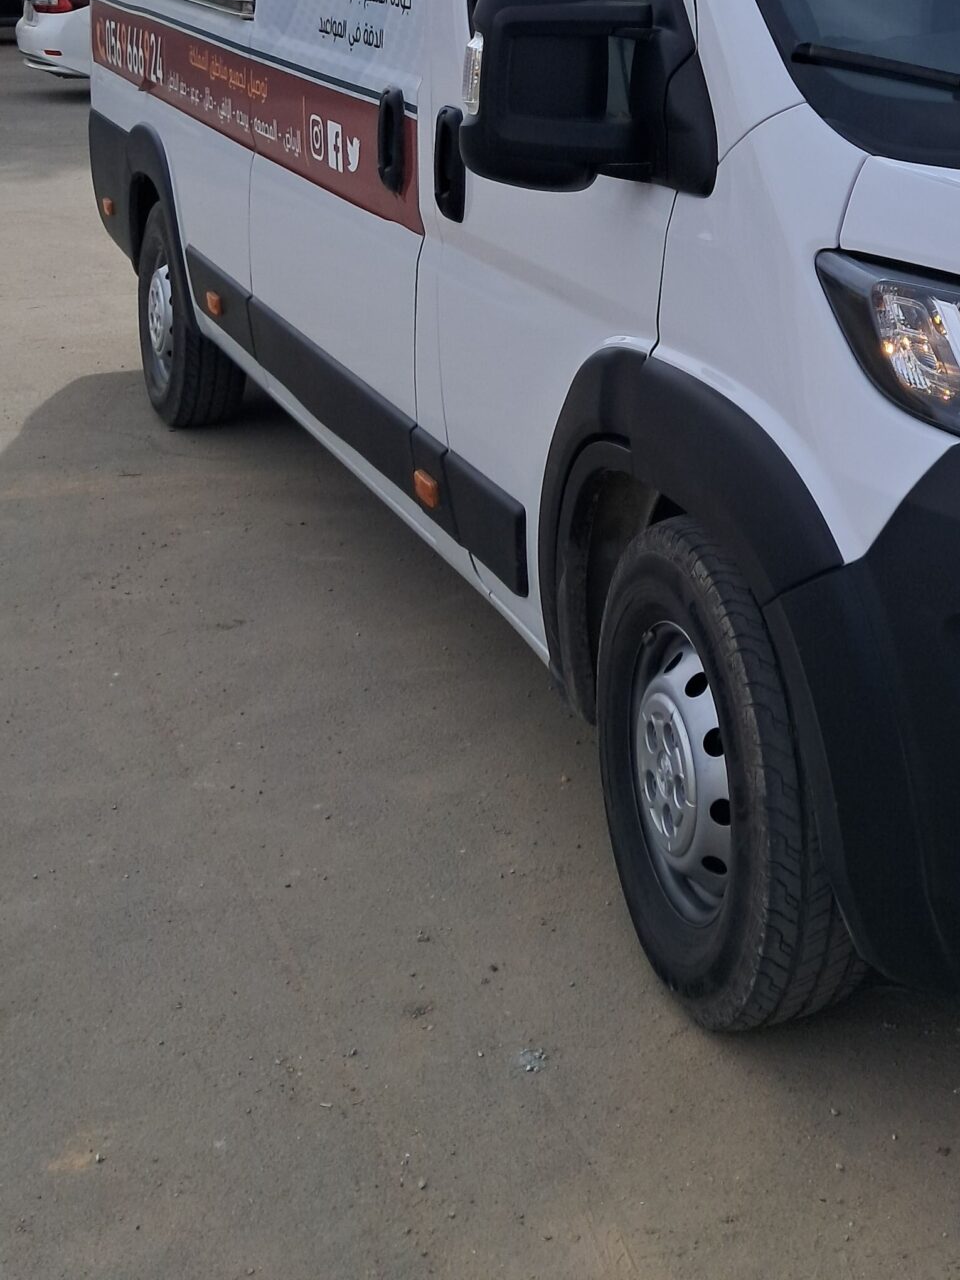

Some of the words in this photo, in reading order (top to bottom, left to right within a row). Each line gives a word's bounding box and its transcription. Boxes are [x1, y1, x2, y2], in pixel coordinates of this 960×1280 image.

[318, 17, 347, 43] المواعيد
[348, 22, 362, 52] في
[363, 23, 384, 50] الدقة
[105, 18, 164, 87] 0569666924
[247, 69, 268, 104] توصيل
